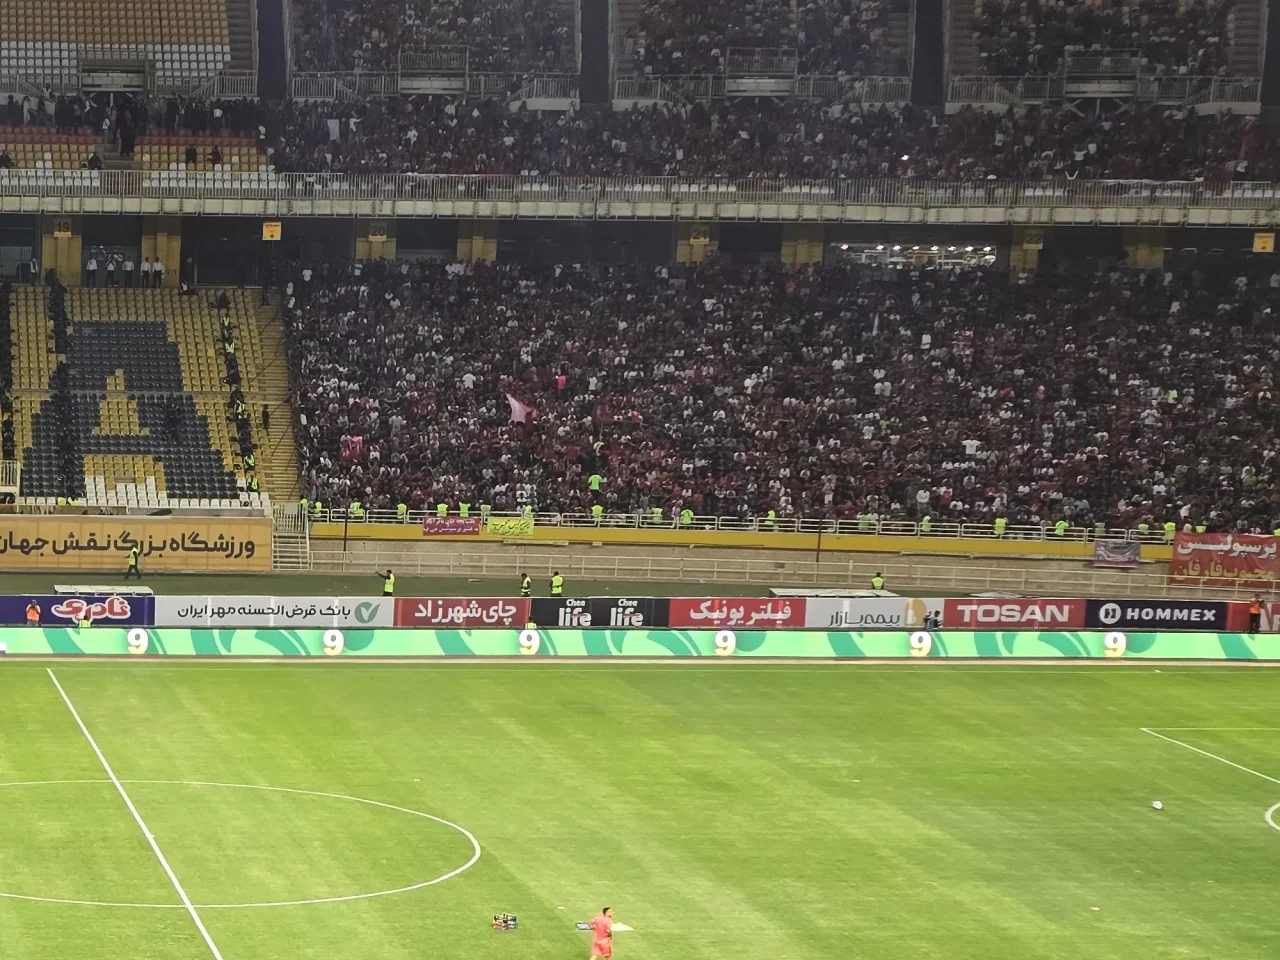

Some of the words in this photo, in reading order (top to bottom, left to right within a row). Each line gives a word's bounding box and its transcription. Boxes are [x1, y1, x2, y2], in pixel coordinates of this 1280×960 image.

[56, 221, 70, 232] 19
[372, 224, 386, 236] 20
[693, 228, 708, 239] 21
[51, 531, 111, 556] نقش
[118, 530, 167, 558] بزرگ
[169, 531, 256, 558] ورزشگاه
[1177, 534, 1277, 560] پرسپولیس
[177, 603, 208, 618] ایران
[209, 604, 236, 618] مهر
[237, 603, 285, 617] الحسنه
[285, 603, 317, 619] قرض
[319, 604, 352, 620] بانک
[414, 600, 482, 623] شهرزاد
[483, 601, 517, 625] چای
[558, 607, 592, 627] life
[610, 607, 644, 627] life
[689, 599, 745, 626] یونیک
[747, 601, 792, 625] فیلتر
[957, 604, 1070, 623] TOSAN
[1126, 607, 1217, 622] HOMMEX
[127, 628, 149, 654] 9
[323, 629, 345, 655] 9
[518, 629, 541, 656] 9
[714, 631, 736, 656] 9
[910, 632, 932, 657] 9
[1103, 632, 1127, 658] 9
